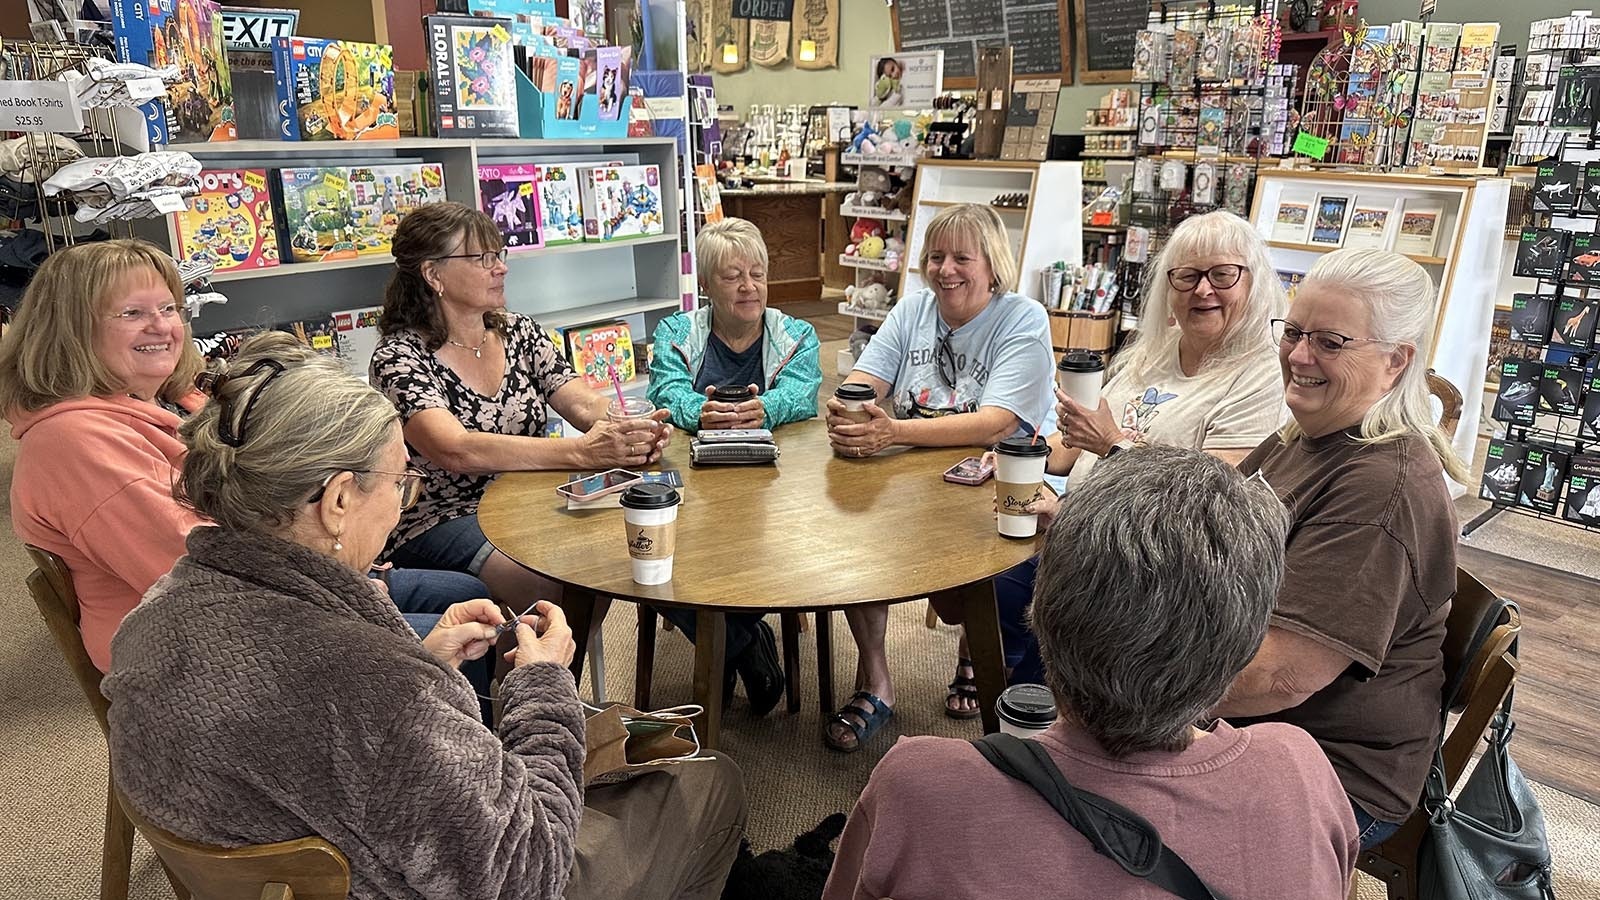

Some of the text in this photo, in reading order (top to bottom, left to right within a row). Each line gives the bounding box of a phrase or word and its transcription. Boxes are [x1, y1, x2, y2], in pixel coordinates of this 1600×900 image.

[134, 2, 144, 21] CITY
[222, 16, 290, 48] EXIT
[307, 45, 323, 57] CITY
[433, 25, 450, 79] FLORAL
[438, 79, 450, 87] ART
[15, 97, 37, 107] Book
[38, 98, 64, 109] T-Shirts
[15, 116, 44, 127] $25.95
[296, 172, 312, 180] CITY
[350, 173, 376, 182] MARIO
[591, 330, 619, 343] DOTS
[908, 348, 947, 367] EDAL
